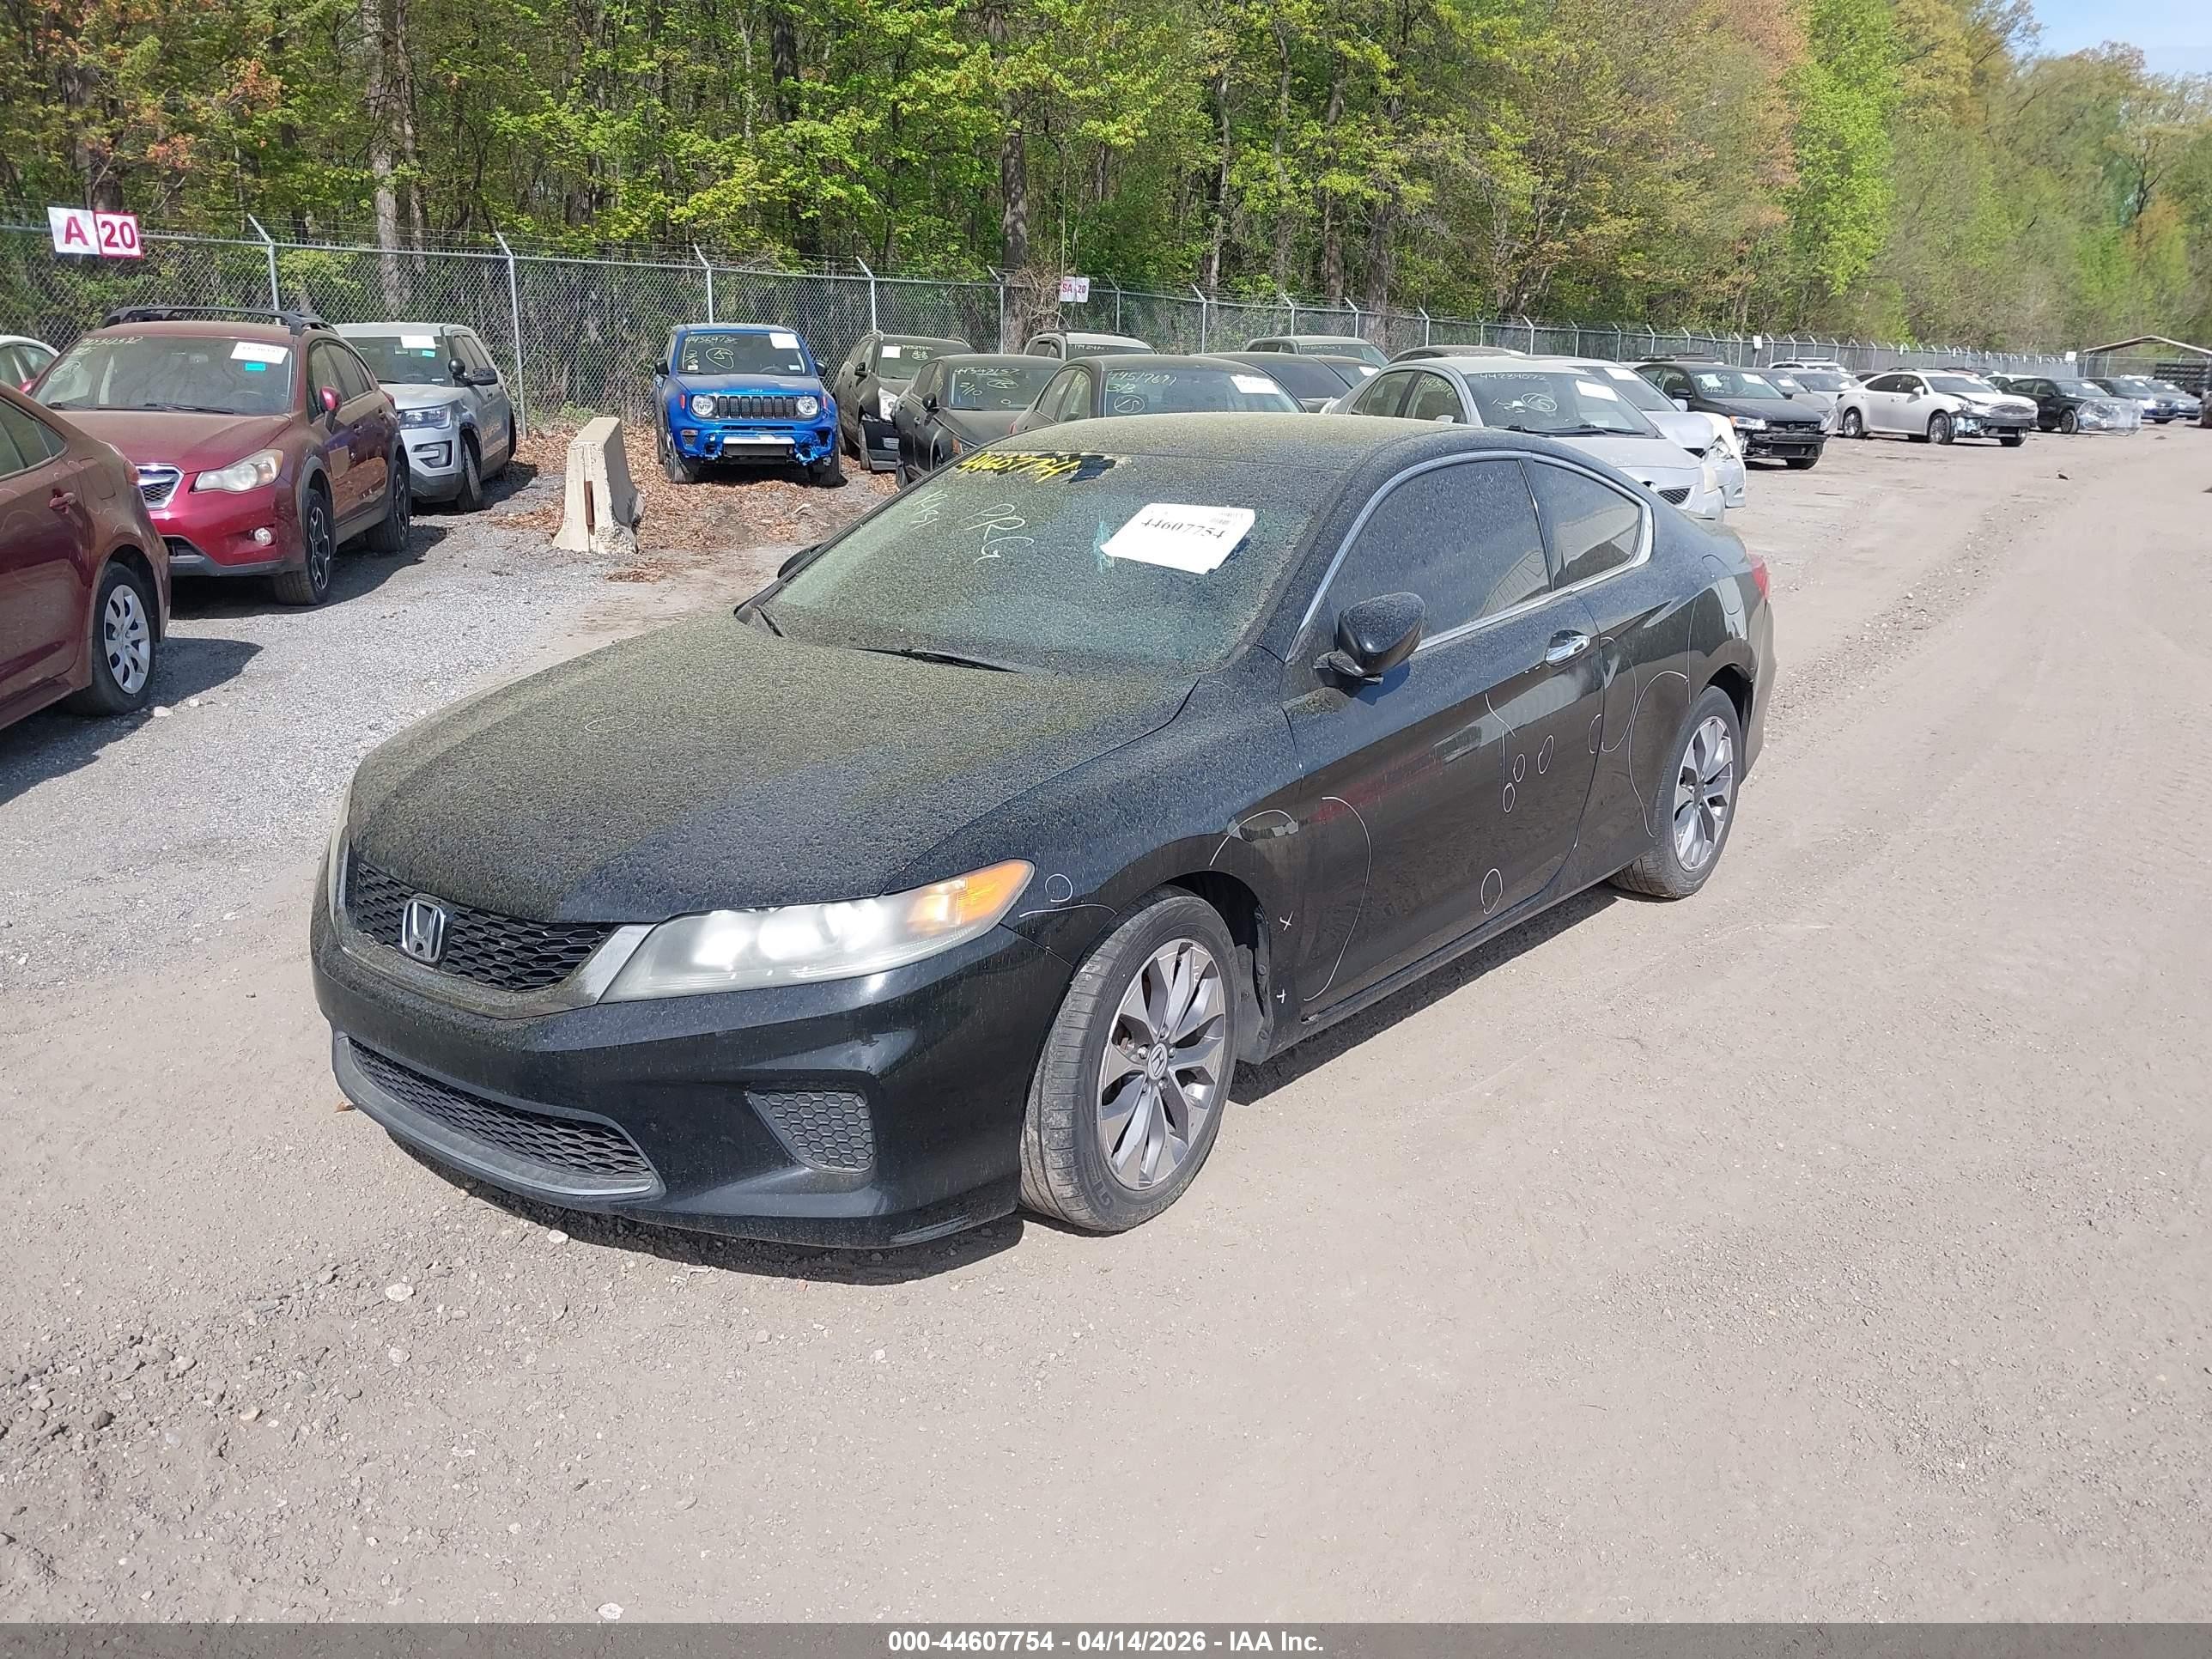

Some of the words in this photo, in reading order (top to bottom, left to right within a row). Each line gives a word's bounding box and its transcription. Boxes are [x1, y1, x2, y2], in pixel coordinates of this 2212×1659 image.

[64, 216, 89, 246] A
[100, 220, 136, 249] 20
[1062, 283, 1073, 294] SA
[1077, 284, 1086, 294] 20
[957, 451, 1082, 483] 44607754
[1140, 518, 1226, 539] 44607754
